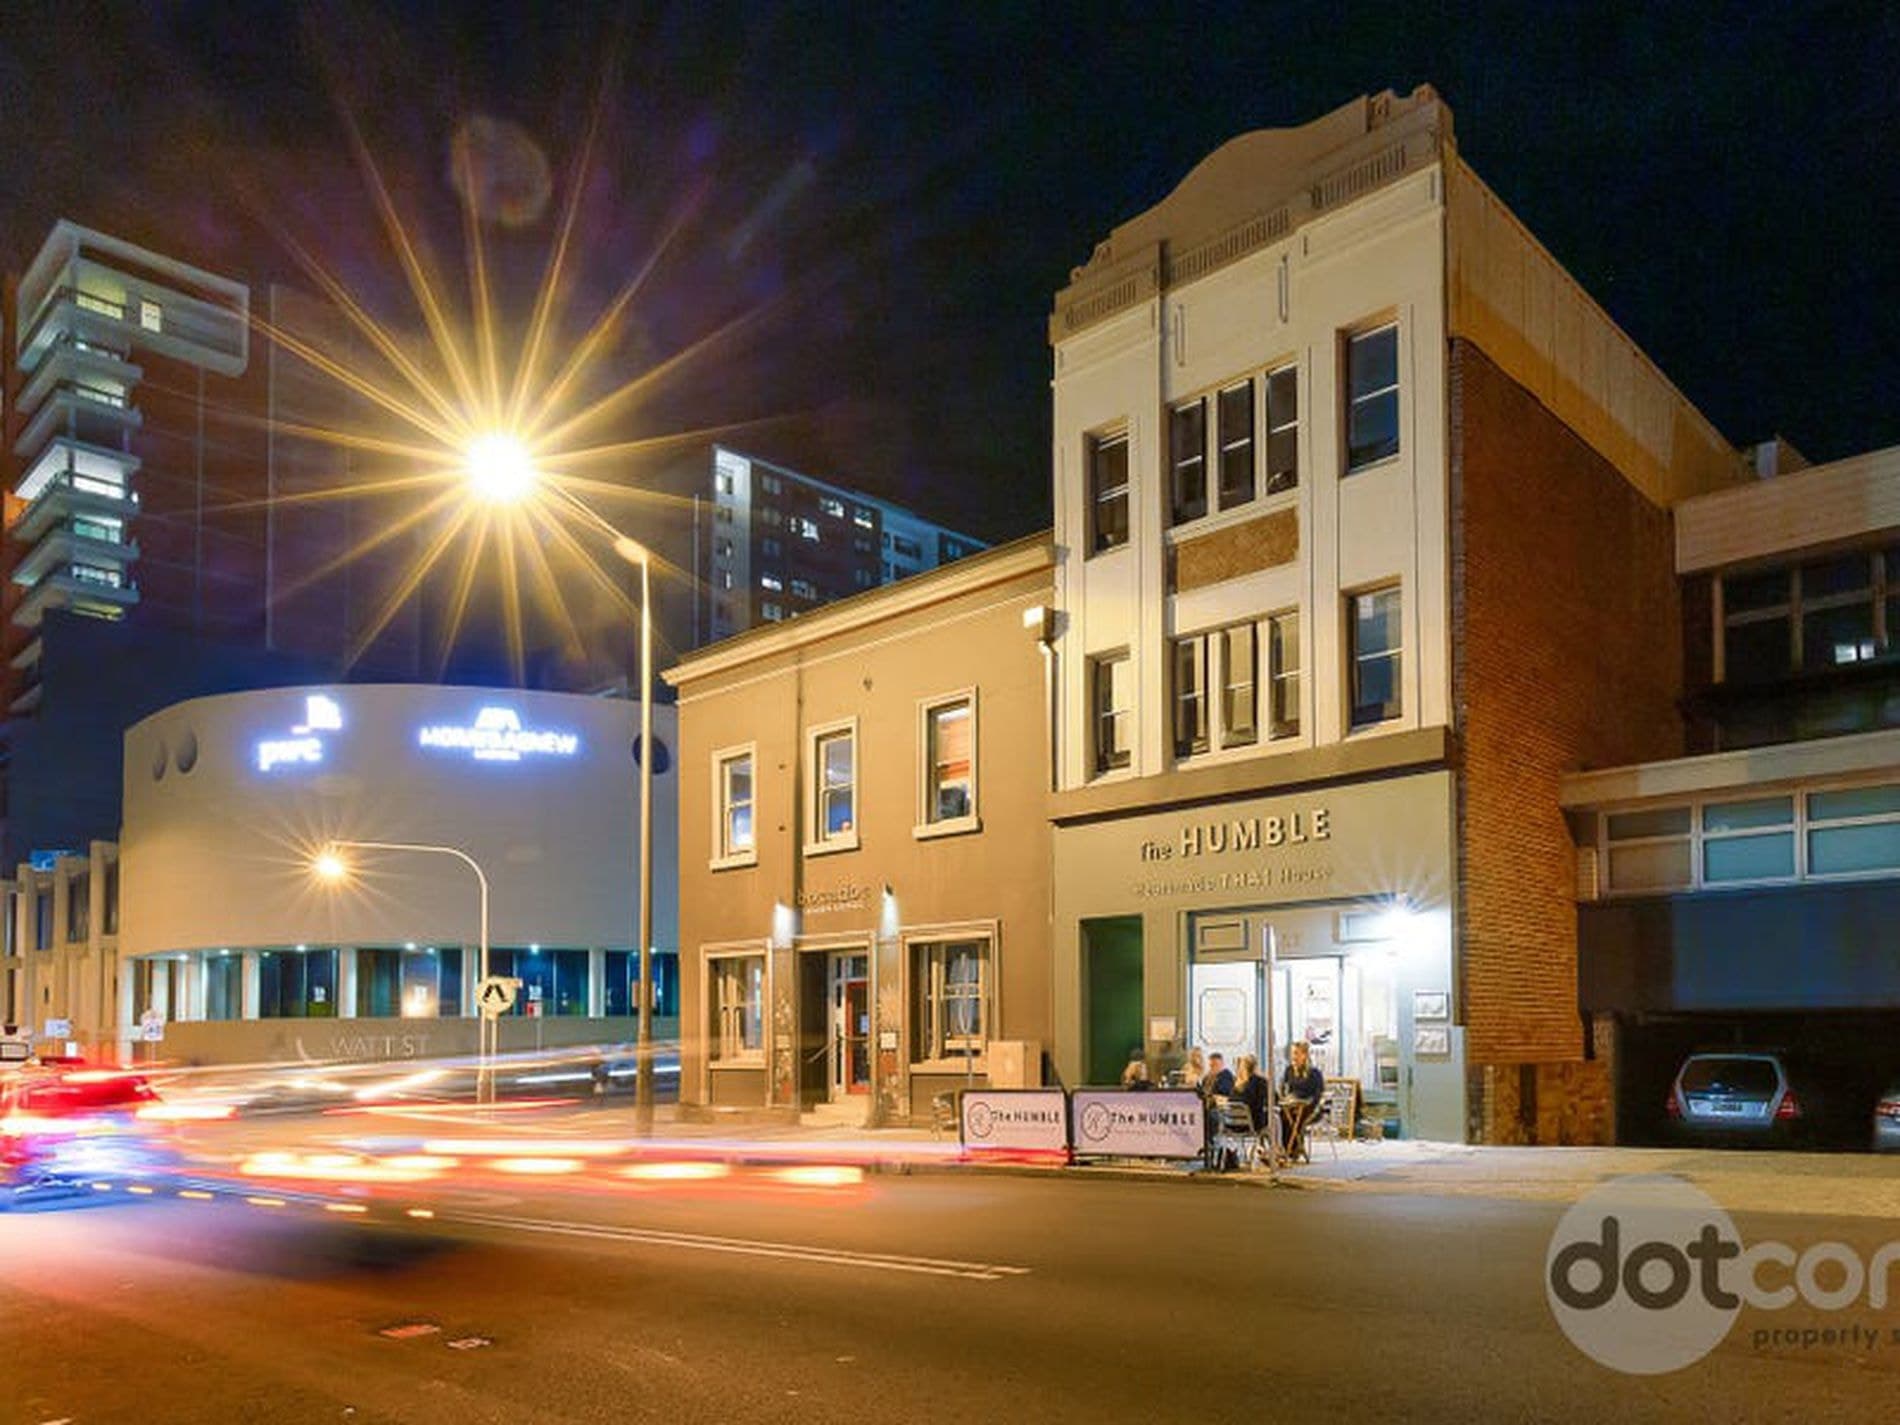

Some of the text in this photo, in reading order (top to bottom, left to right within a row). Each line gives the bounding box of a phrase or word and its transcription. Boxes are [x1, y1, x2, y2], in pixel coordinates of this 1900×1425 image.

[1181, 808, 1331, 857] HUMBLE
[329, 1034, 432, 1059] WATT ST
[1138, 1112, 1196, 1126] HUMBLE
